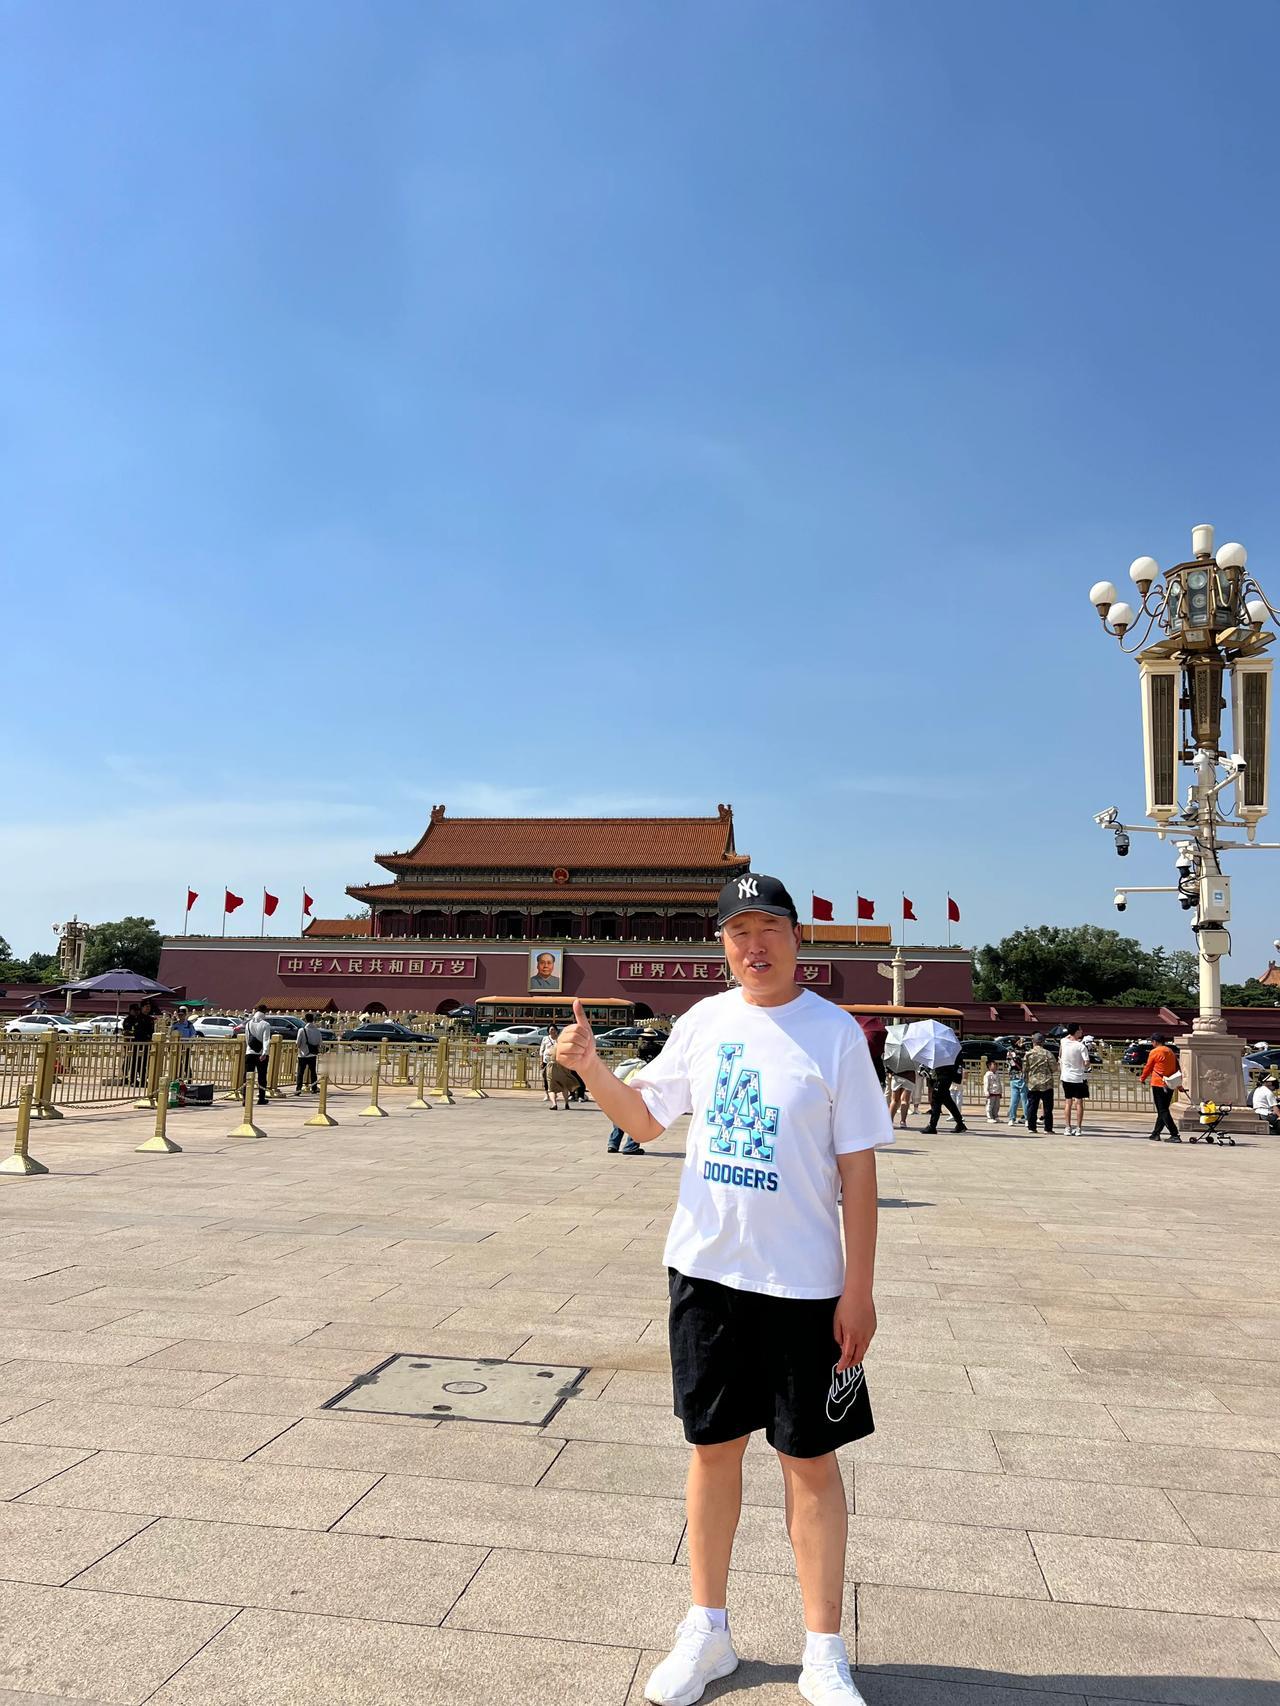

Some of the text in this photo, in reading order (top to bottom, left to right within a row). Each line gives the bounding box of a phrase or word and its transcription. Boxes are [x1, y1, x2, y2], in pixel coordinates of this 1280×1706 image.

[738, 877, 759, 900] NY
[287, 958, 466, 975] 中华人民共和国万岁
[628, 962, 820, 981] 世界人民大岁
[707, 1043, 779, 1163] LA
[703, 1160, 779, 1192] DODGERS
